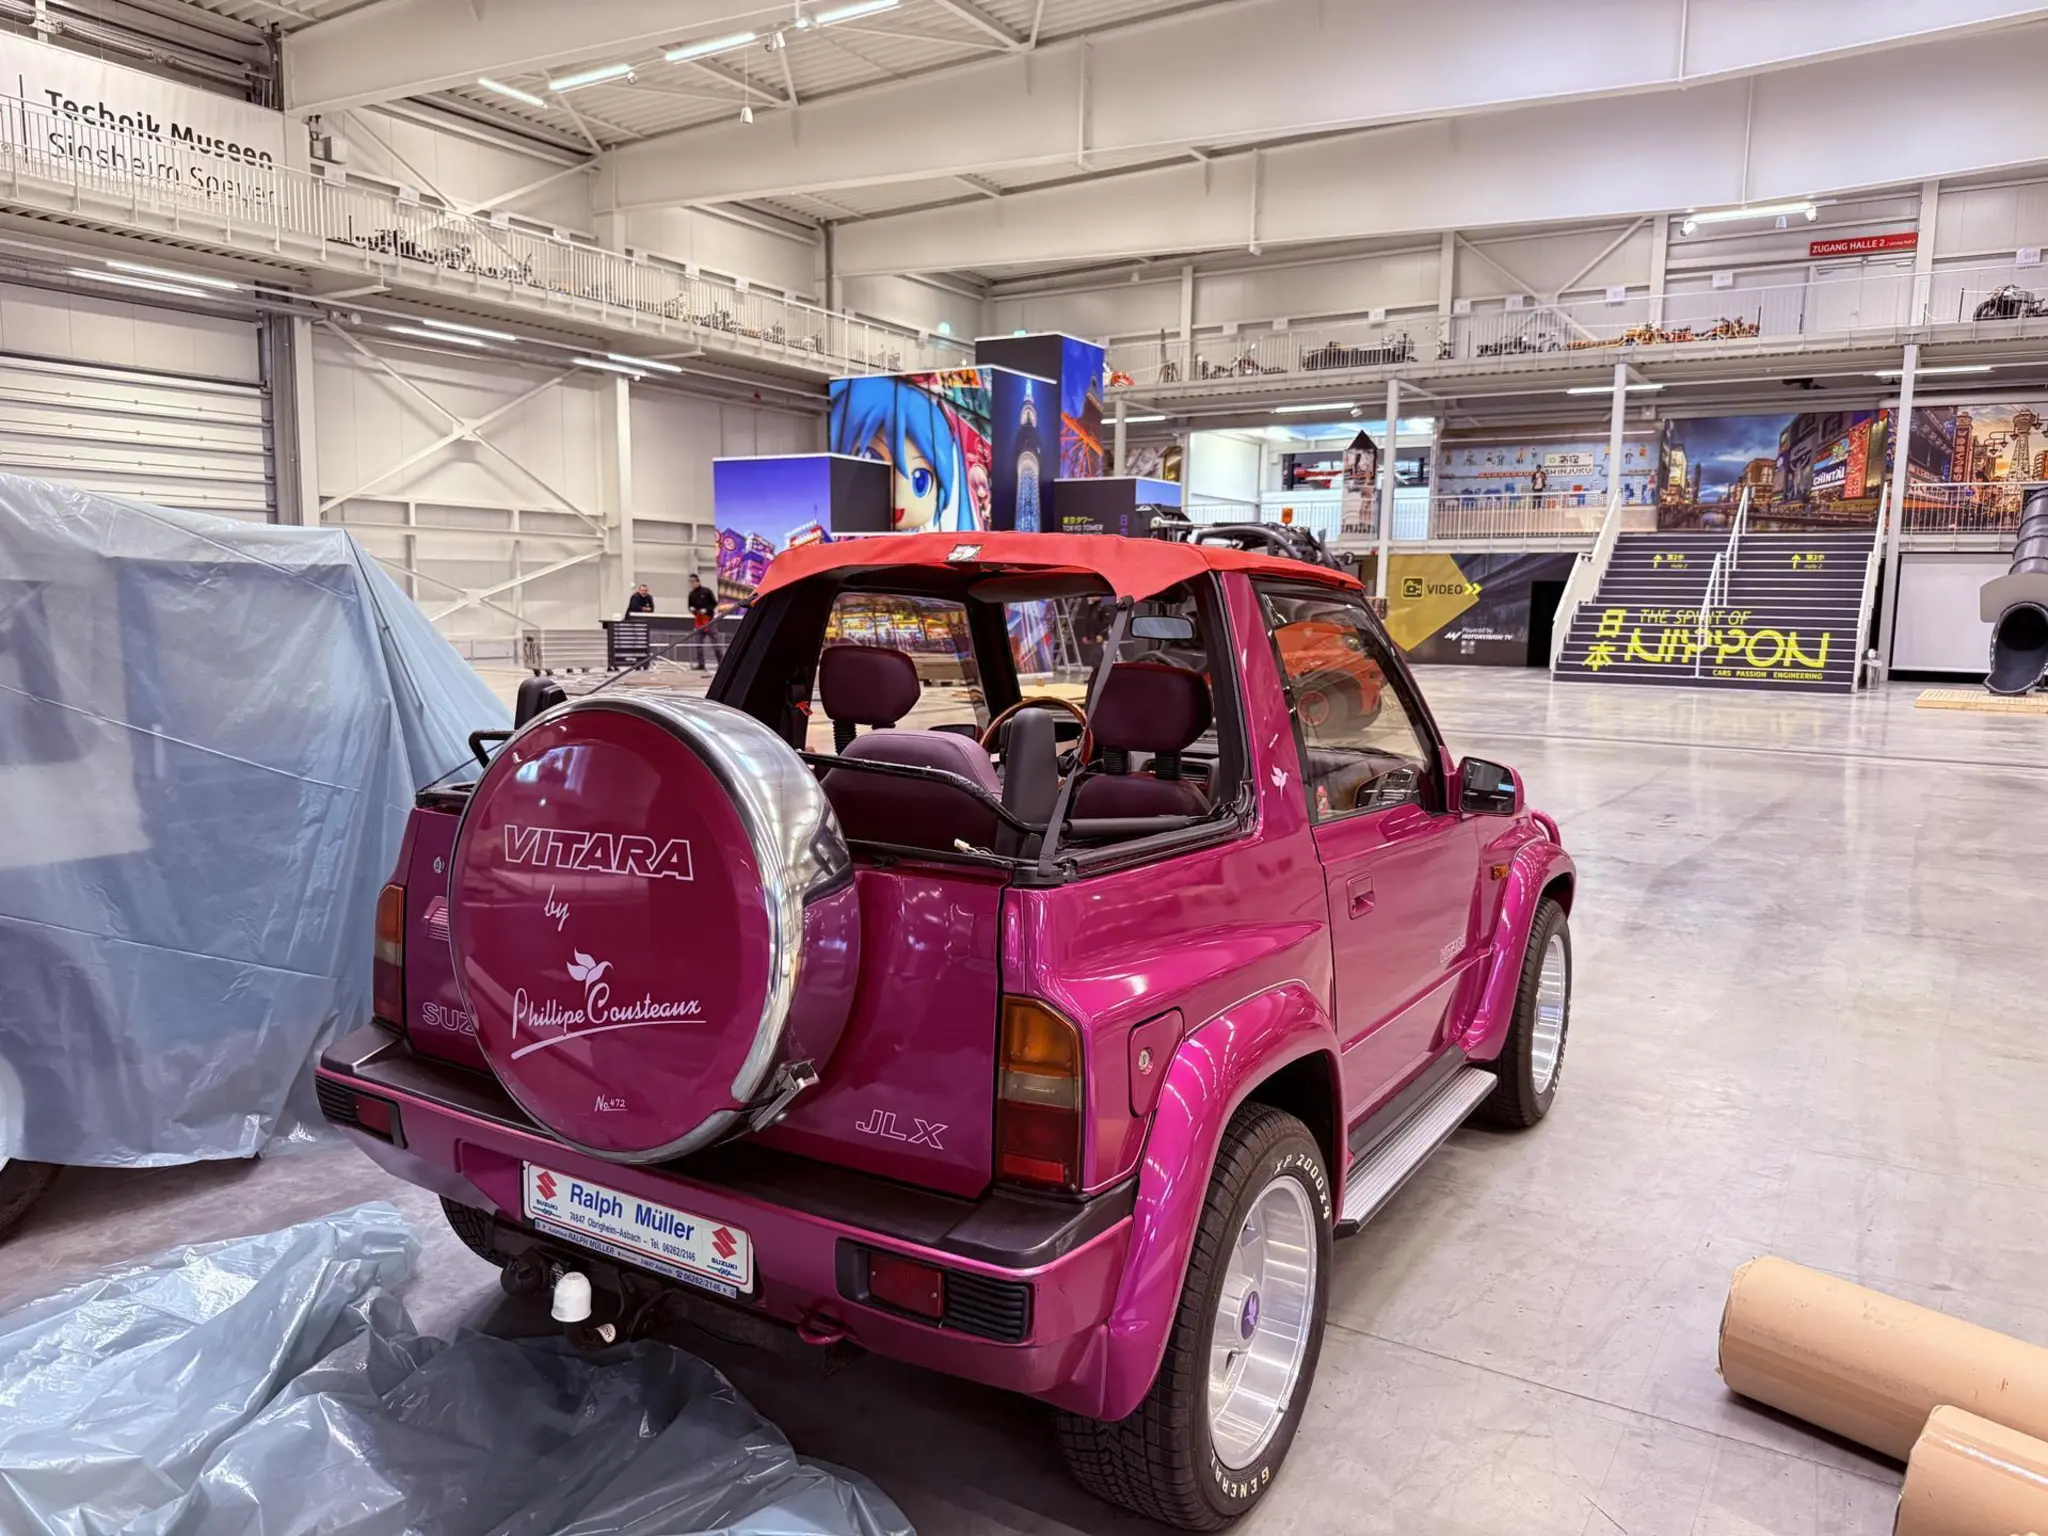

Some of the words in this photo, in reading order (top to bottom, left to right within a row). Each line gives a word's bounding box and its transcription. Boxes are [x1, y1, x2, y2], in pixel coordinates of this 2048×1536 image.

[45, 89, 162, 142] Technik
[171, 122, 273, 170] Museen
[49, 132, 180, 186] Sinsheim
[1812, 241, 1848, 254] ZUGANG
[1850, 240, 1877, 250] HALLE
[1879, 239, 1885, 247] 2
[1062, 524, 1082, 532] TOKYO
[1427, 584, 1463, 595] VIDEO
[1640, 608, 1668, 624] THE
[1728, 610, 1752, 625] OF
[1582, 609, 1627, 671] 日本
[1624, 627, 1830, 668] NIPPON
[1712, 669, 1732, 677] CARS
[1736, 670, 1767, 678] PASSION
[1773, 671, 1823, 680] ENGINEERING
[504, 824, 694, 881] VITARA
[544, 884, 570, 932] by
[512, 987, 585, 1039] Phillipe
[587, 982, 702, 1024] Cousteaux
[855, 1108, 949, 1150] JLX
[535, 1198, 558, 1211] SUZUKI
[570, 1182, 623, 1218] Ralph
[635, 1203, 695, 1241] Müller
[568, 1232, 589, 1246] RALPH
[589, 1239, 614, 1255] MÜLLER
[587, 1217, 641, 1243] Obrigheim-Asbach
[711, 1257, 738, 1270] SUZUKI
[683, 1274, 721, 1293] 06262/2146
[1210, 1448, 1270, 1498] GENERAL
